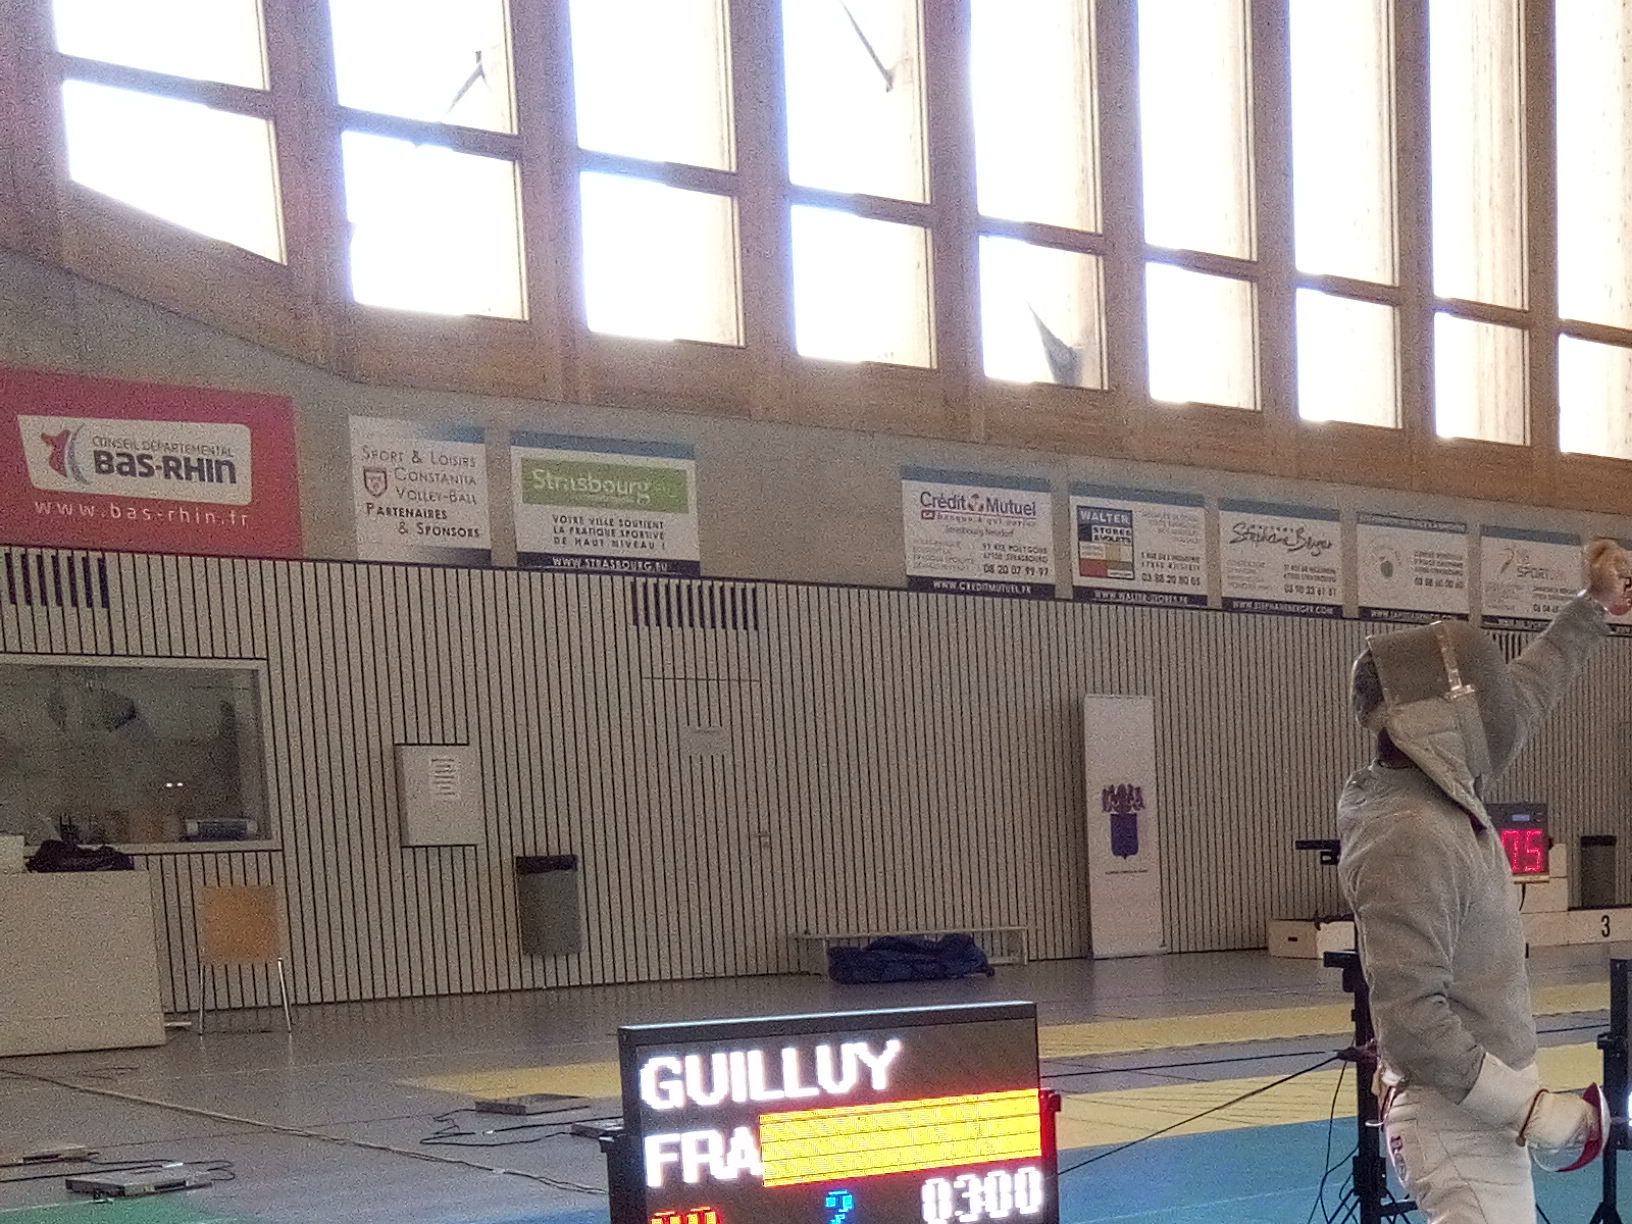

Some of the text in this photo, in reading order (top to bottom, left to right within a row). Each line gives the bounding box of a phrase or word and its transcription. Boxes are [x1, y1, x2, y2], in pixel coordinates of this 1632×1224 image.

[92, 435, 138, 451] CONSEIL
[362, 446, 476, 468] SPORT & LOISIRS
[395, 467, 477, 486] CONSTANTIA
[396, 486, 477, 505] VOLLEY-BALL
[920, 491, 1036, 516] Crédit Mutuel
[35, 502, 248, 526] www.bas-rhin.fr
[366, 502, 448, 520] PARTENAIRES
[1080, 509, 1130, 525] WALTER
[398, 521, 480, 538] & SPONSORS
[552, 514, 584, 526] VOTRE
[618, 519, 664, 530] SOUTIENT
[553, 526, 664, 541] LA PRATIQUE SPORTIVE
[554, 537, 567, 546] DE
[575, 538, 605, 547] HAUT
[611, 540, 655, 551] NIVEAU
[552, 557, 668, 573] WWW.STRASBOURG.EU
[1601, 914, 1611, 938] 3
[639, 1039, 903, 1111] GUILLUY
[644, 1126, 762, 1188] FRA
